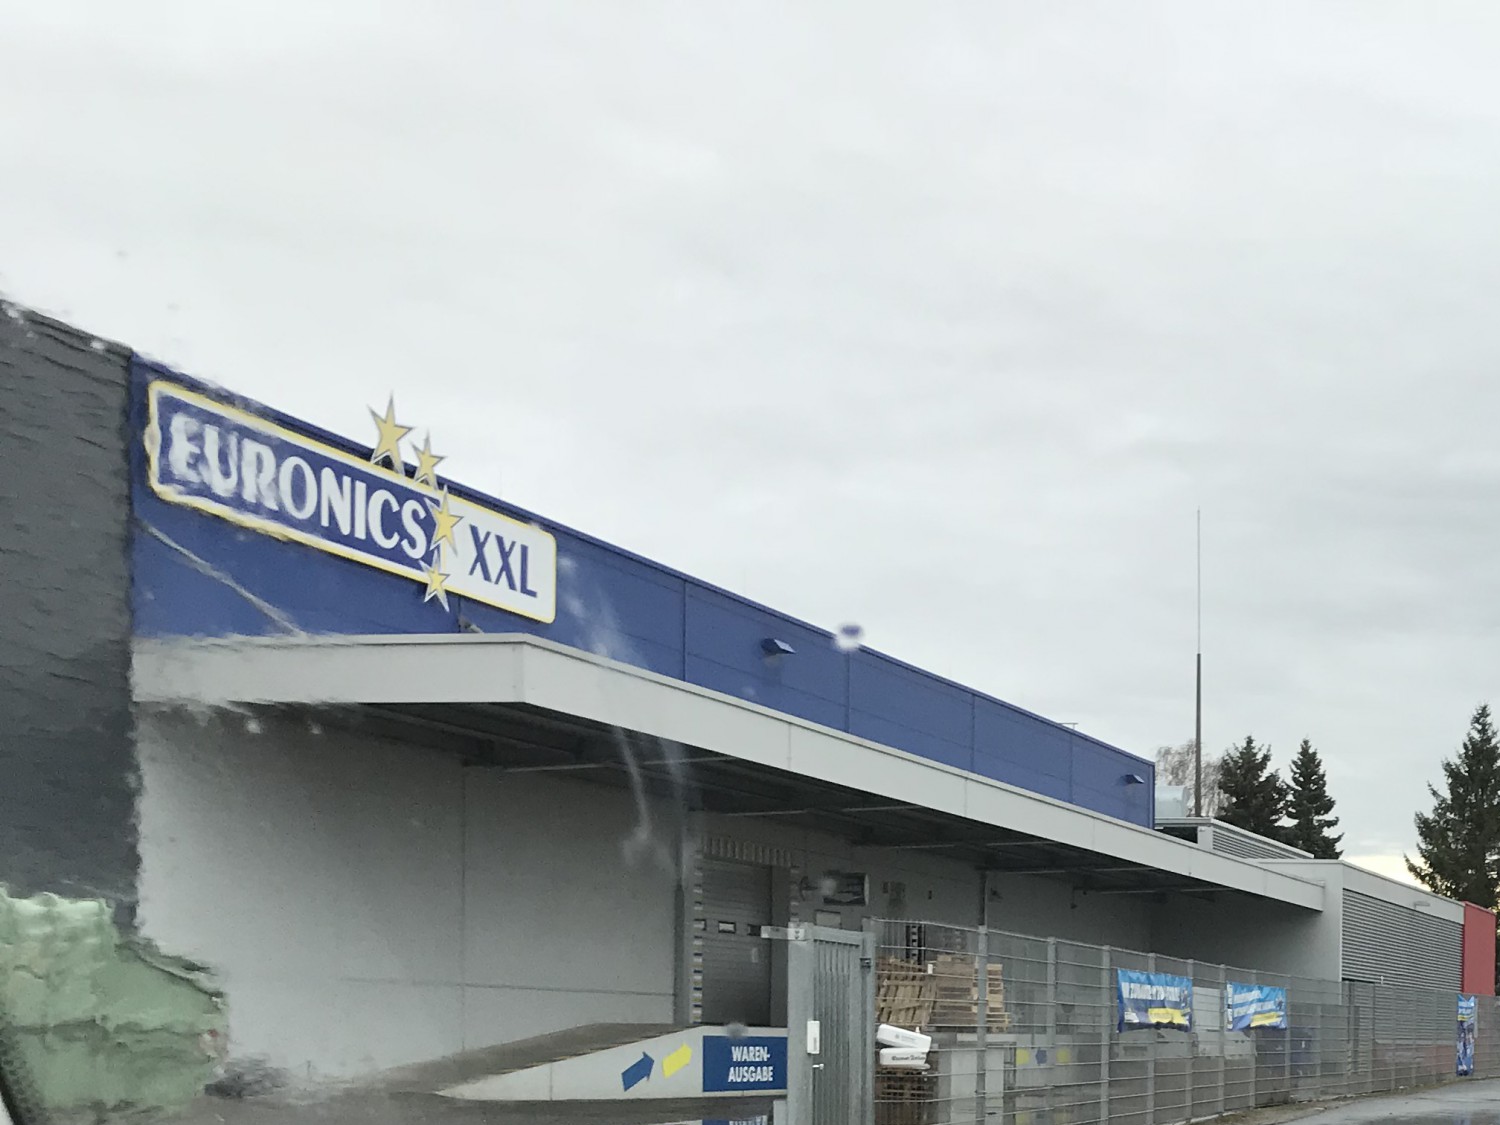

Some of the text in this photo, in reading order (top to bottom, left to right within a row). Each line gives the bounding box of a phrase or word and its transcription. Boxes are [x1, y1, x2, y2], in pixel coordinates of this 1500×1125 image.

[168, 411, 427, 560] EURONICS
[468, 523, 538, 599] XXL
[728, 1066, 774, 1083] AUSGABE
[731, 1046, 770, 1062] WAREN-
